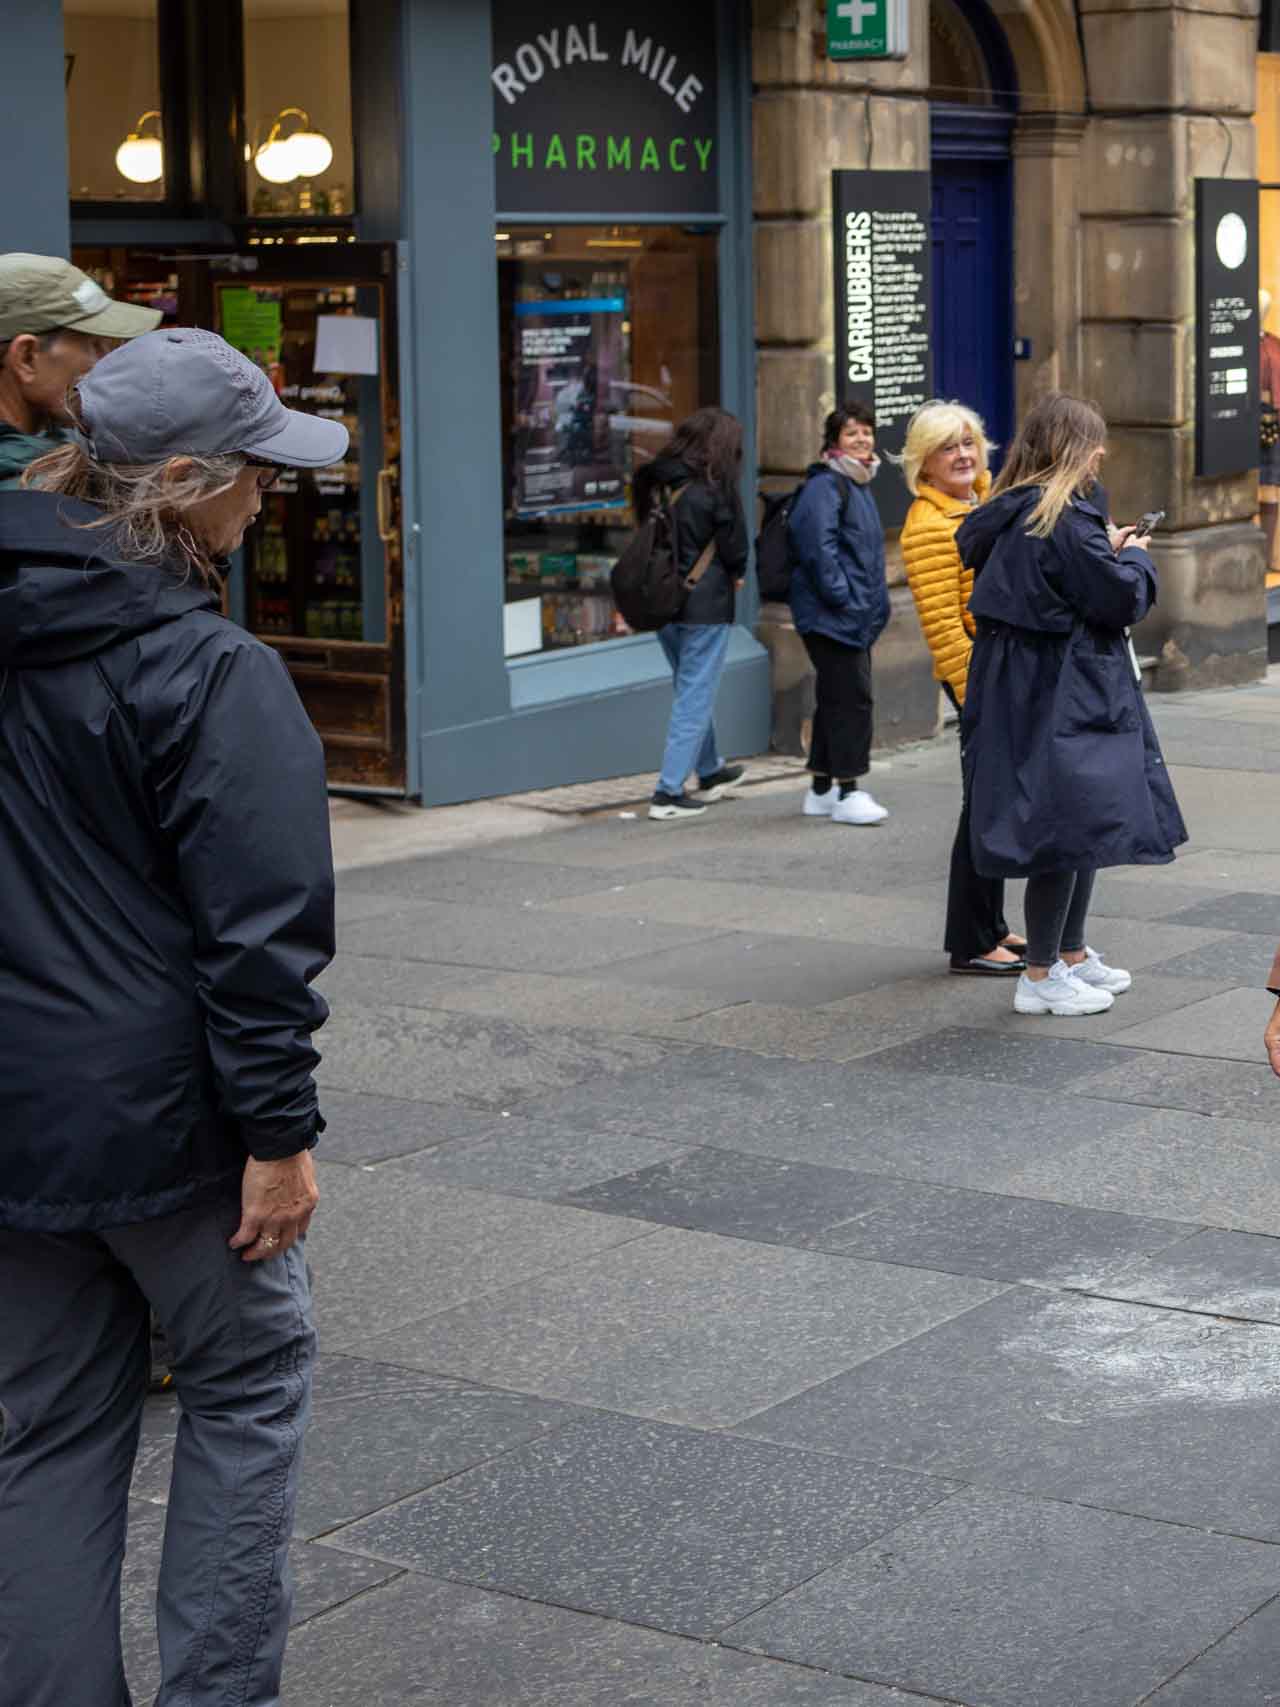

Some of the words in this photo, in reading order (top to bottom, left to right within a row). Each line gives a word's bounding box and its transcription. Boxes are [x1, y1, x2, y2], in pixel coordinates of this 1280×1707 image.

[491, 22, 609, 104] ROYAL
[621, 29, 704, 112] MILE
[845, 211, 874, 383] CARRUBBERS
